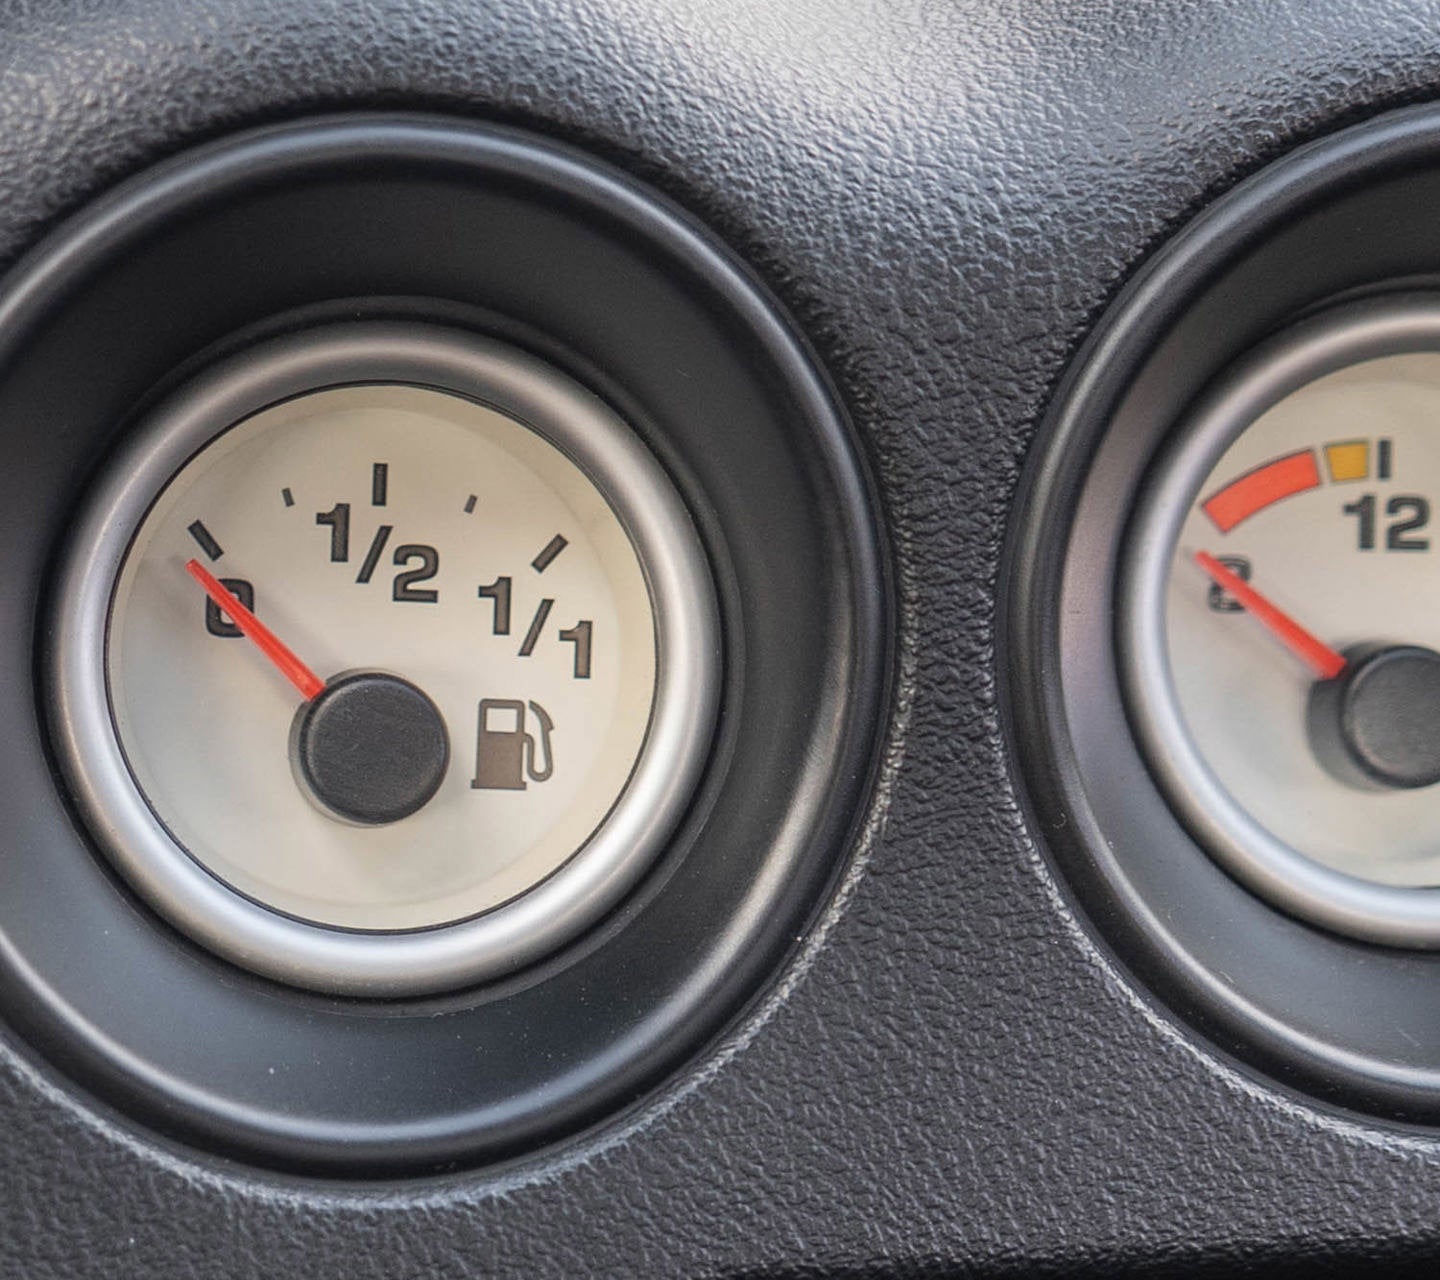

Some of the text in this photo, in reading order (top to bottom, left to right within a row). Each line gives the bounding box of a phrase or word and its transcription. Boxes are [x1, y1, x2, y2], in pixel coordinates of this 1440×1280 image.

[315, 502, 440, 603] 1/2
[1343, 494, 1431, 552] 12
[205, 577, 255, 638] 0
[477, 576, 594, 679] 1/1
